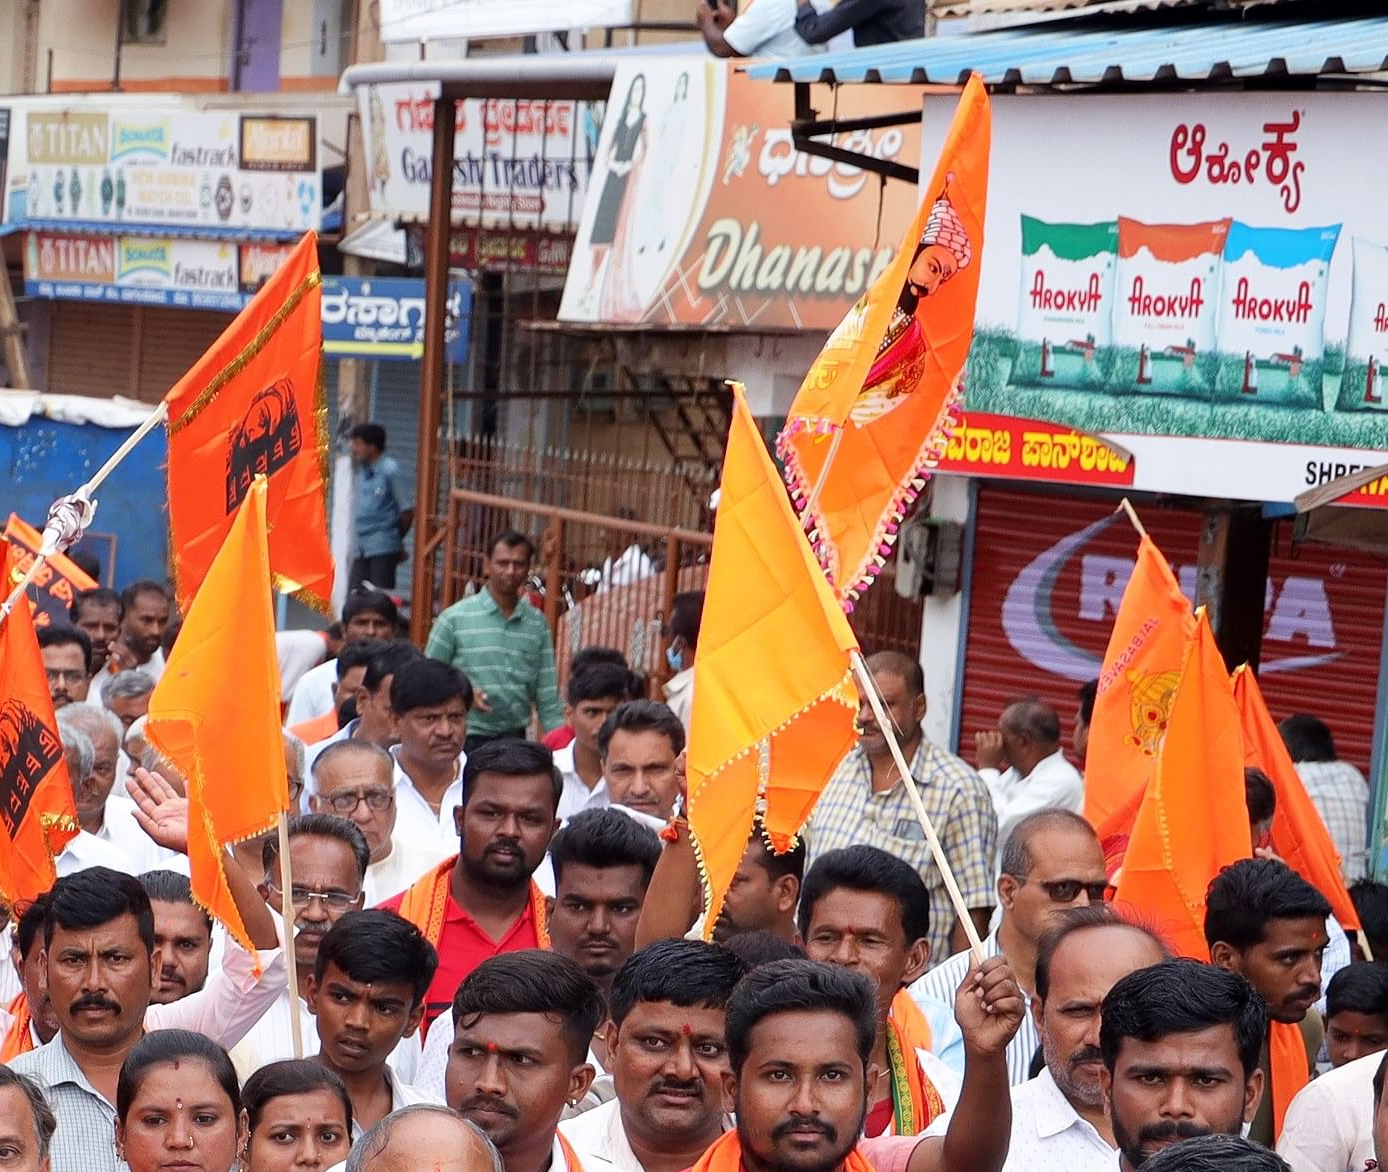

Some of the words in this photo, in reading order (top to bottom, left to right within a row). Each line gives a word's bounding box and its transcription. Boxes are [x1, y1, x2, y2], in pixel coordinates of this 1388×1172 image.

[47, 124, 107, 157] TITAN
[172, 140, 239, 168] fastrack
[402, 145, 482, 187] Gash
[489, 151, 578, 192] Traders
[55, 238, 113, 274] TITAN
[173, 261, 238, 291] fastrack
[1030, 270, 1102, 313] AROKYA
[1128, 275, 1204, 318] AROKYA
[1232, 277, 1313, 324] AROKYA
[1078, 553, 1336, 650] RA
